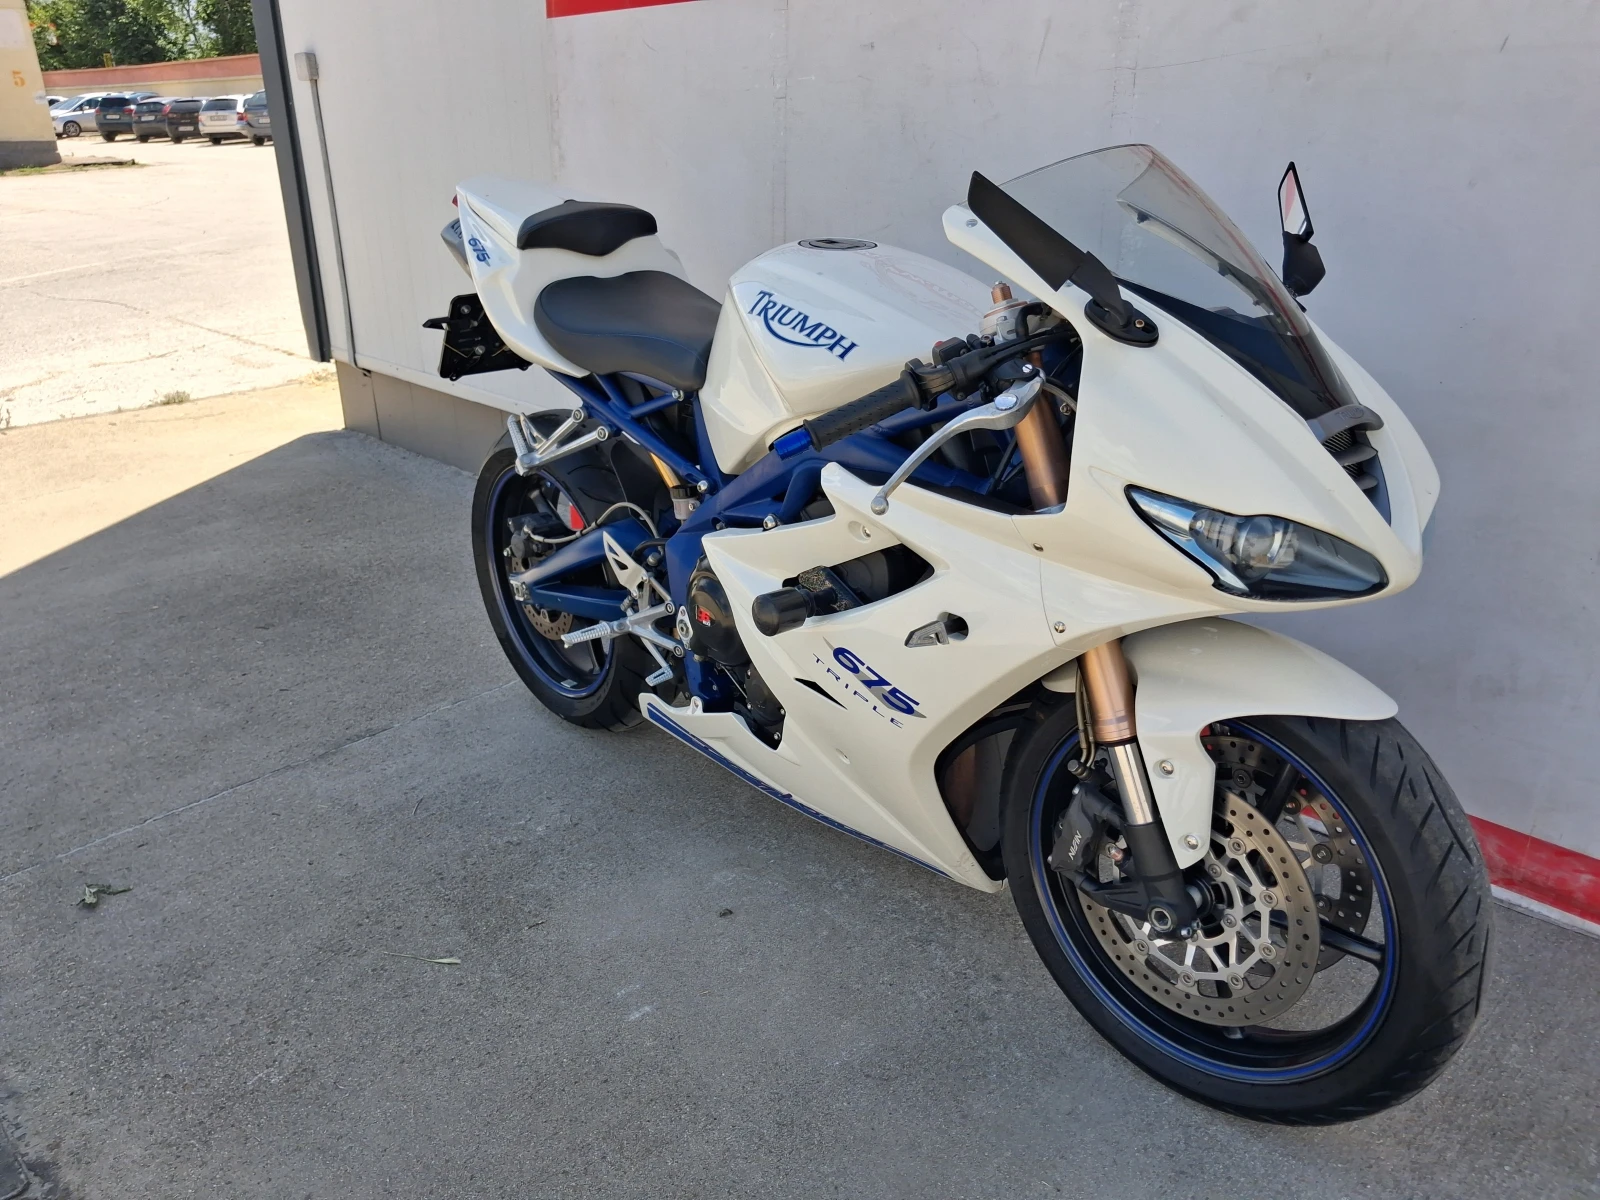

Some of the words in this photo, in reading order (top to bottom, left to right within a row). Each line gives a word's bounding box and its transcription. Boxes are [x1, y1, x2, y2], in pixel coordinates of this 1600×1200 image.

[12, 70, 26, 87] 5
[468, 237, 490, 262] 675
[748, 290, 860, 362] TRIUMPH
[812, 653, 904, 729] TRIPLE
[832, 646, 920, 715] 675
[1068, 830, 1082, 860] NISSIN
